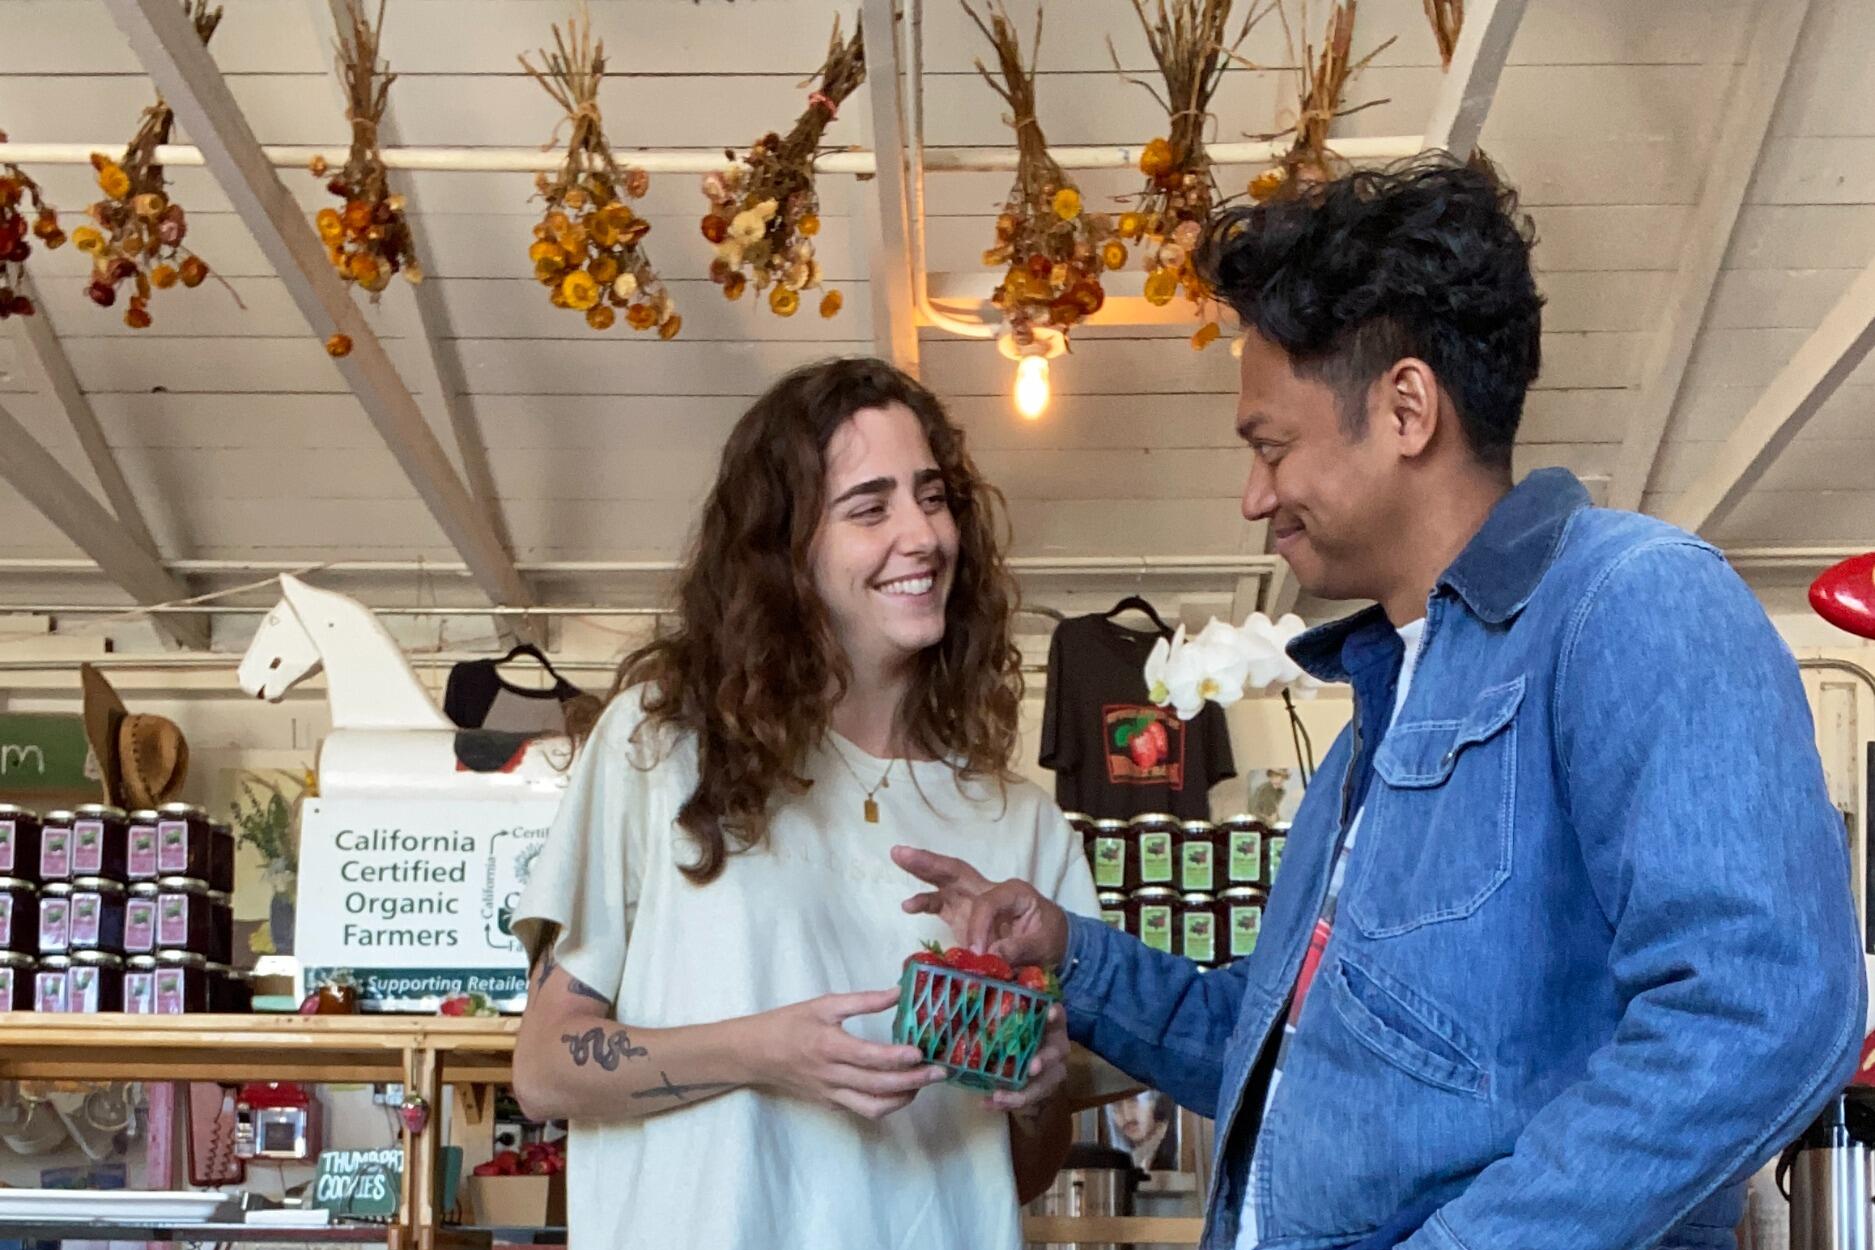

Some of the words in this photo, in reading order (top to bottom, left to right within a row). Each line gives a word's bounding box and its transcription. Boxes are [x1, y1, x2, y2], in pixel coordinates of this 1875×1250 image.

[1, 744, 45, 775] m
[335, 828, 476, 852] California
[511, 826, 551, 840] Certif
[340, 860, 467, 883] Certified
[481, 855, 497, 920] California
[344, 891, 460, 920] Organic
[343, 923, 459, 947] Farmers
[367, 975, 462, 997] Supporting
